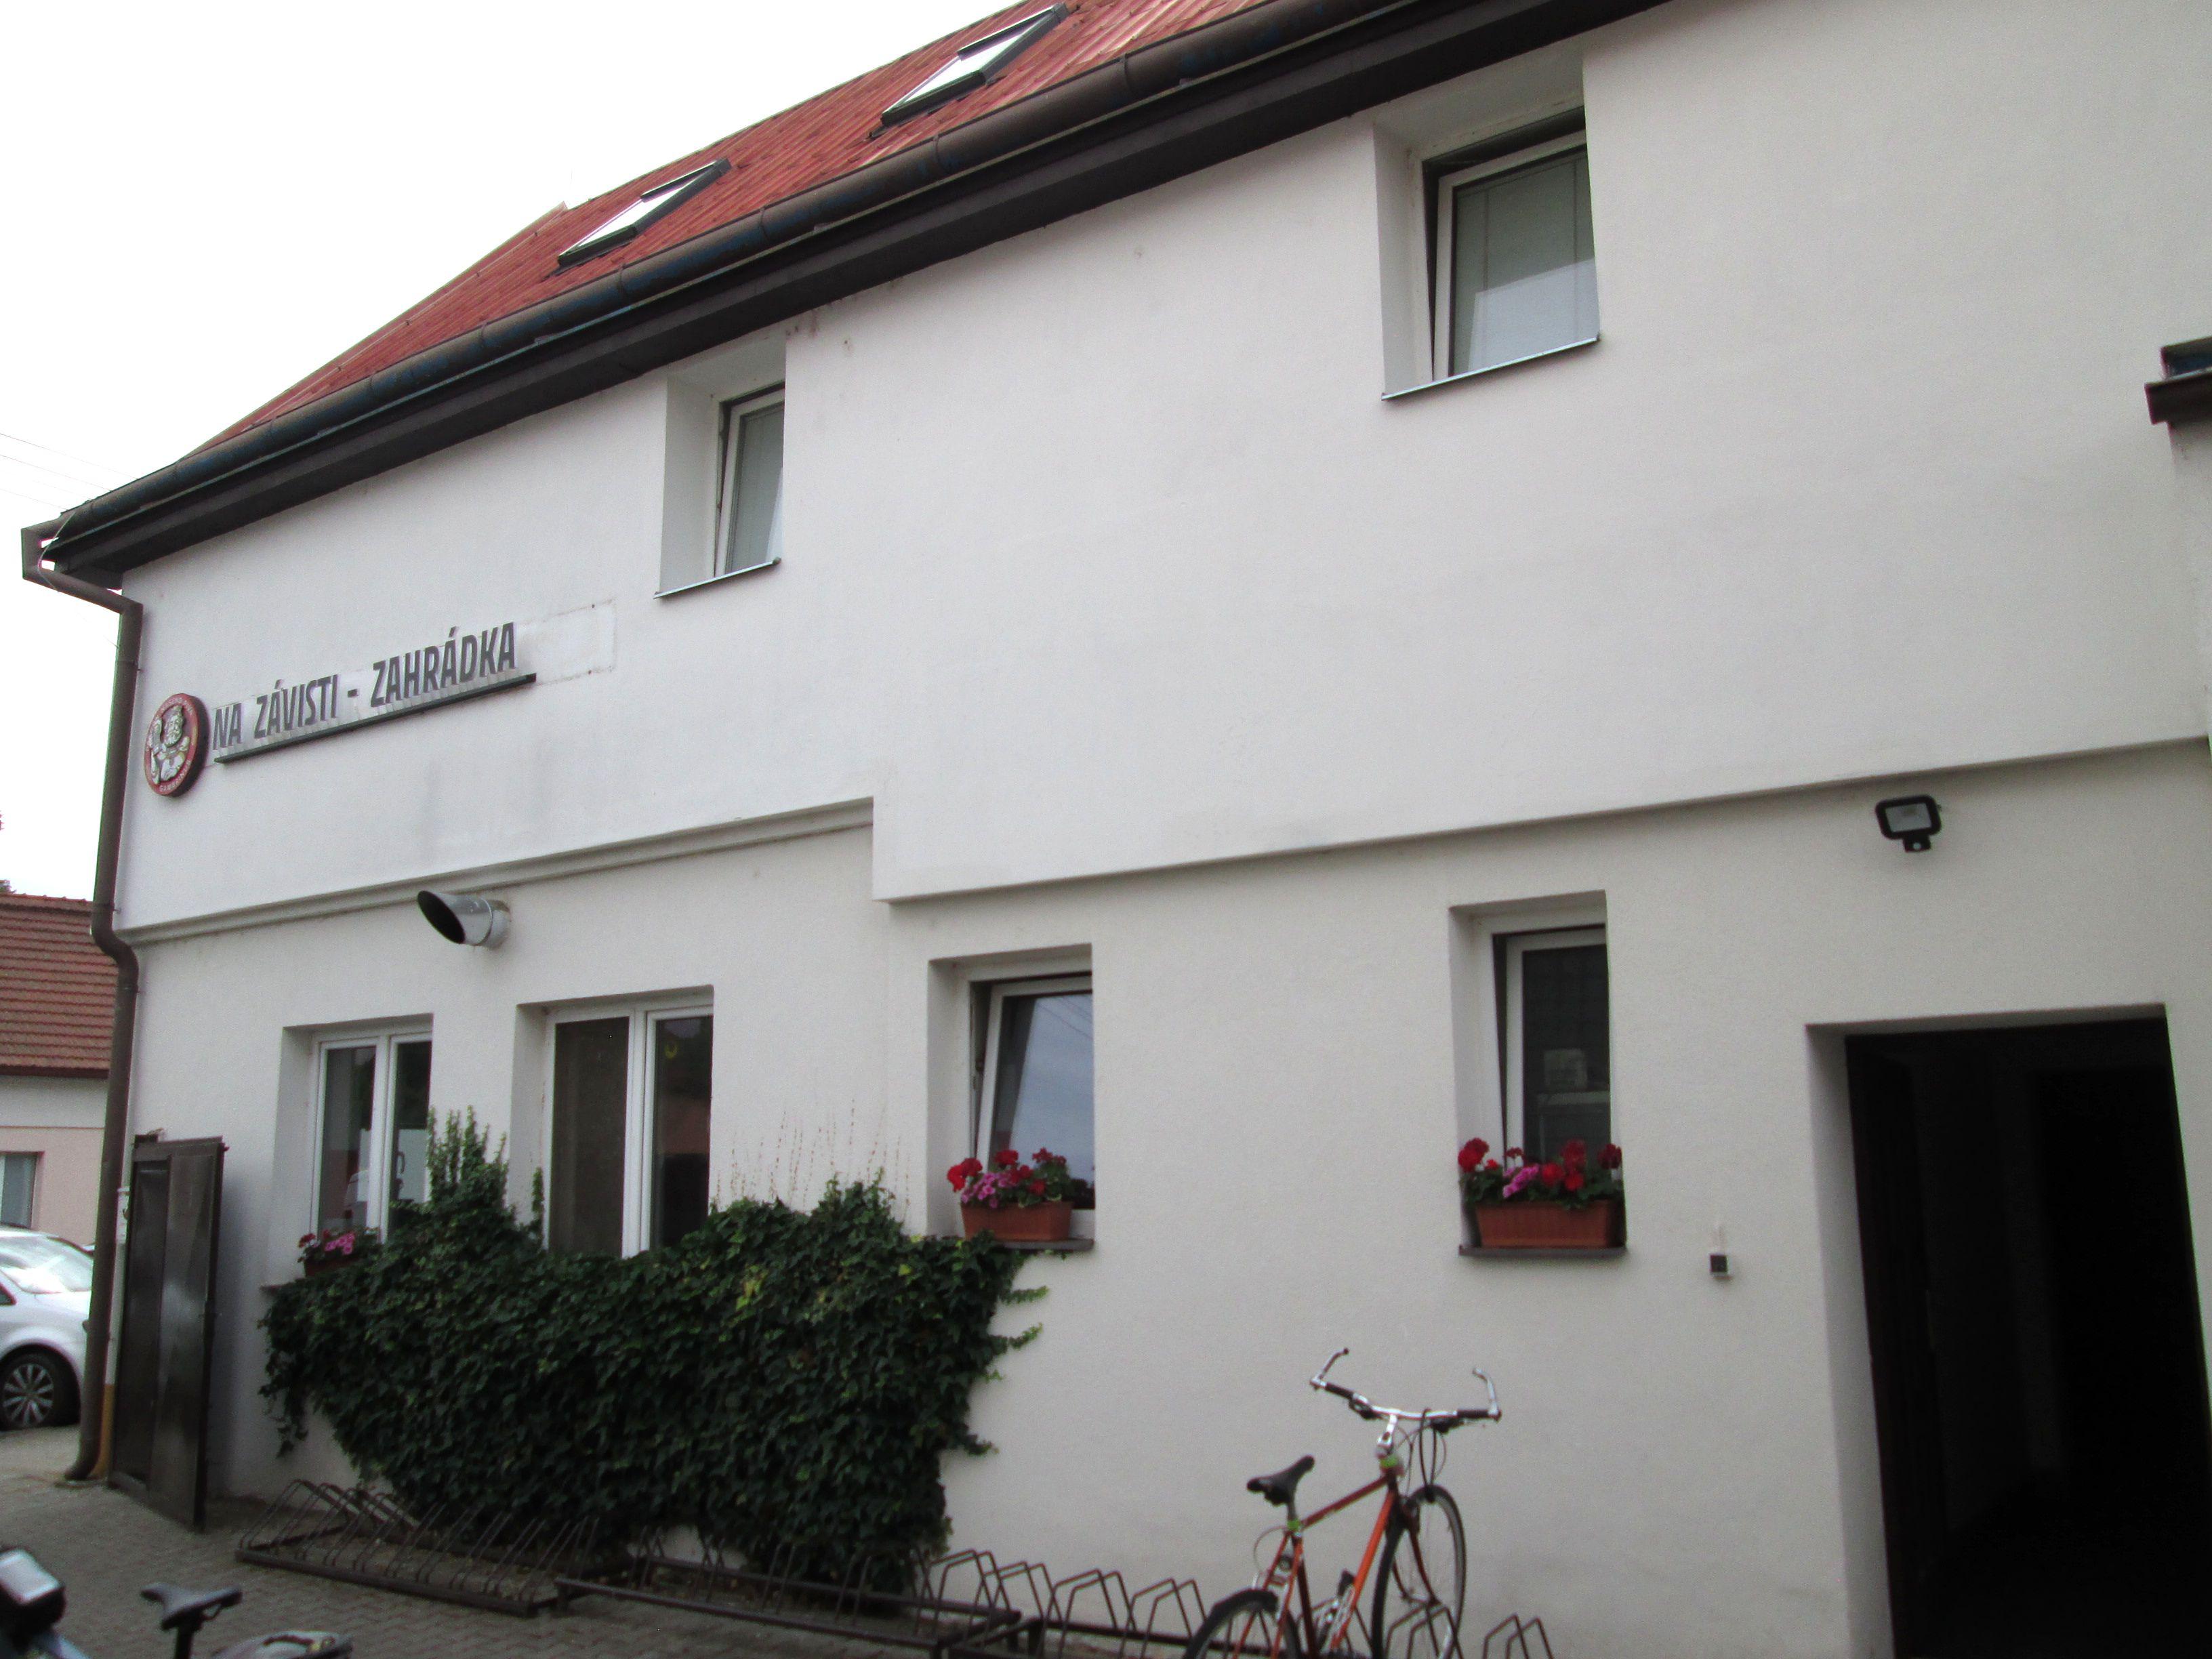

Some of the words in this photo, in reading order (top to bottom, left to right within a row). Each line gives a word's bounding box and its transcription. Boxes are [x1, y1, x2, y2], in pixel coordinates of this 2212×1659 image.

[213, 703, 242, 750] NA
[253, 675, 338, 739] ZÁVISTI
[371, 621, 516, 708] ZAHRÁDKA
